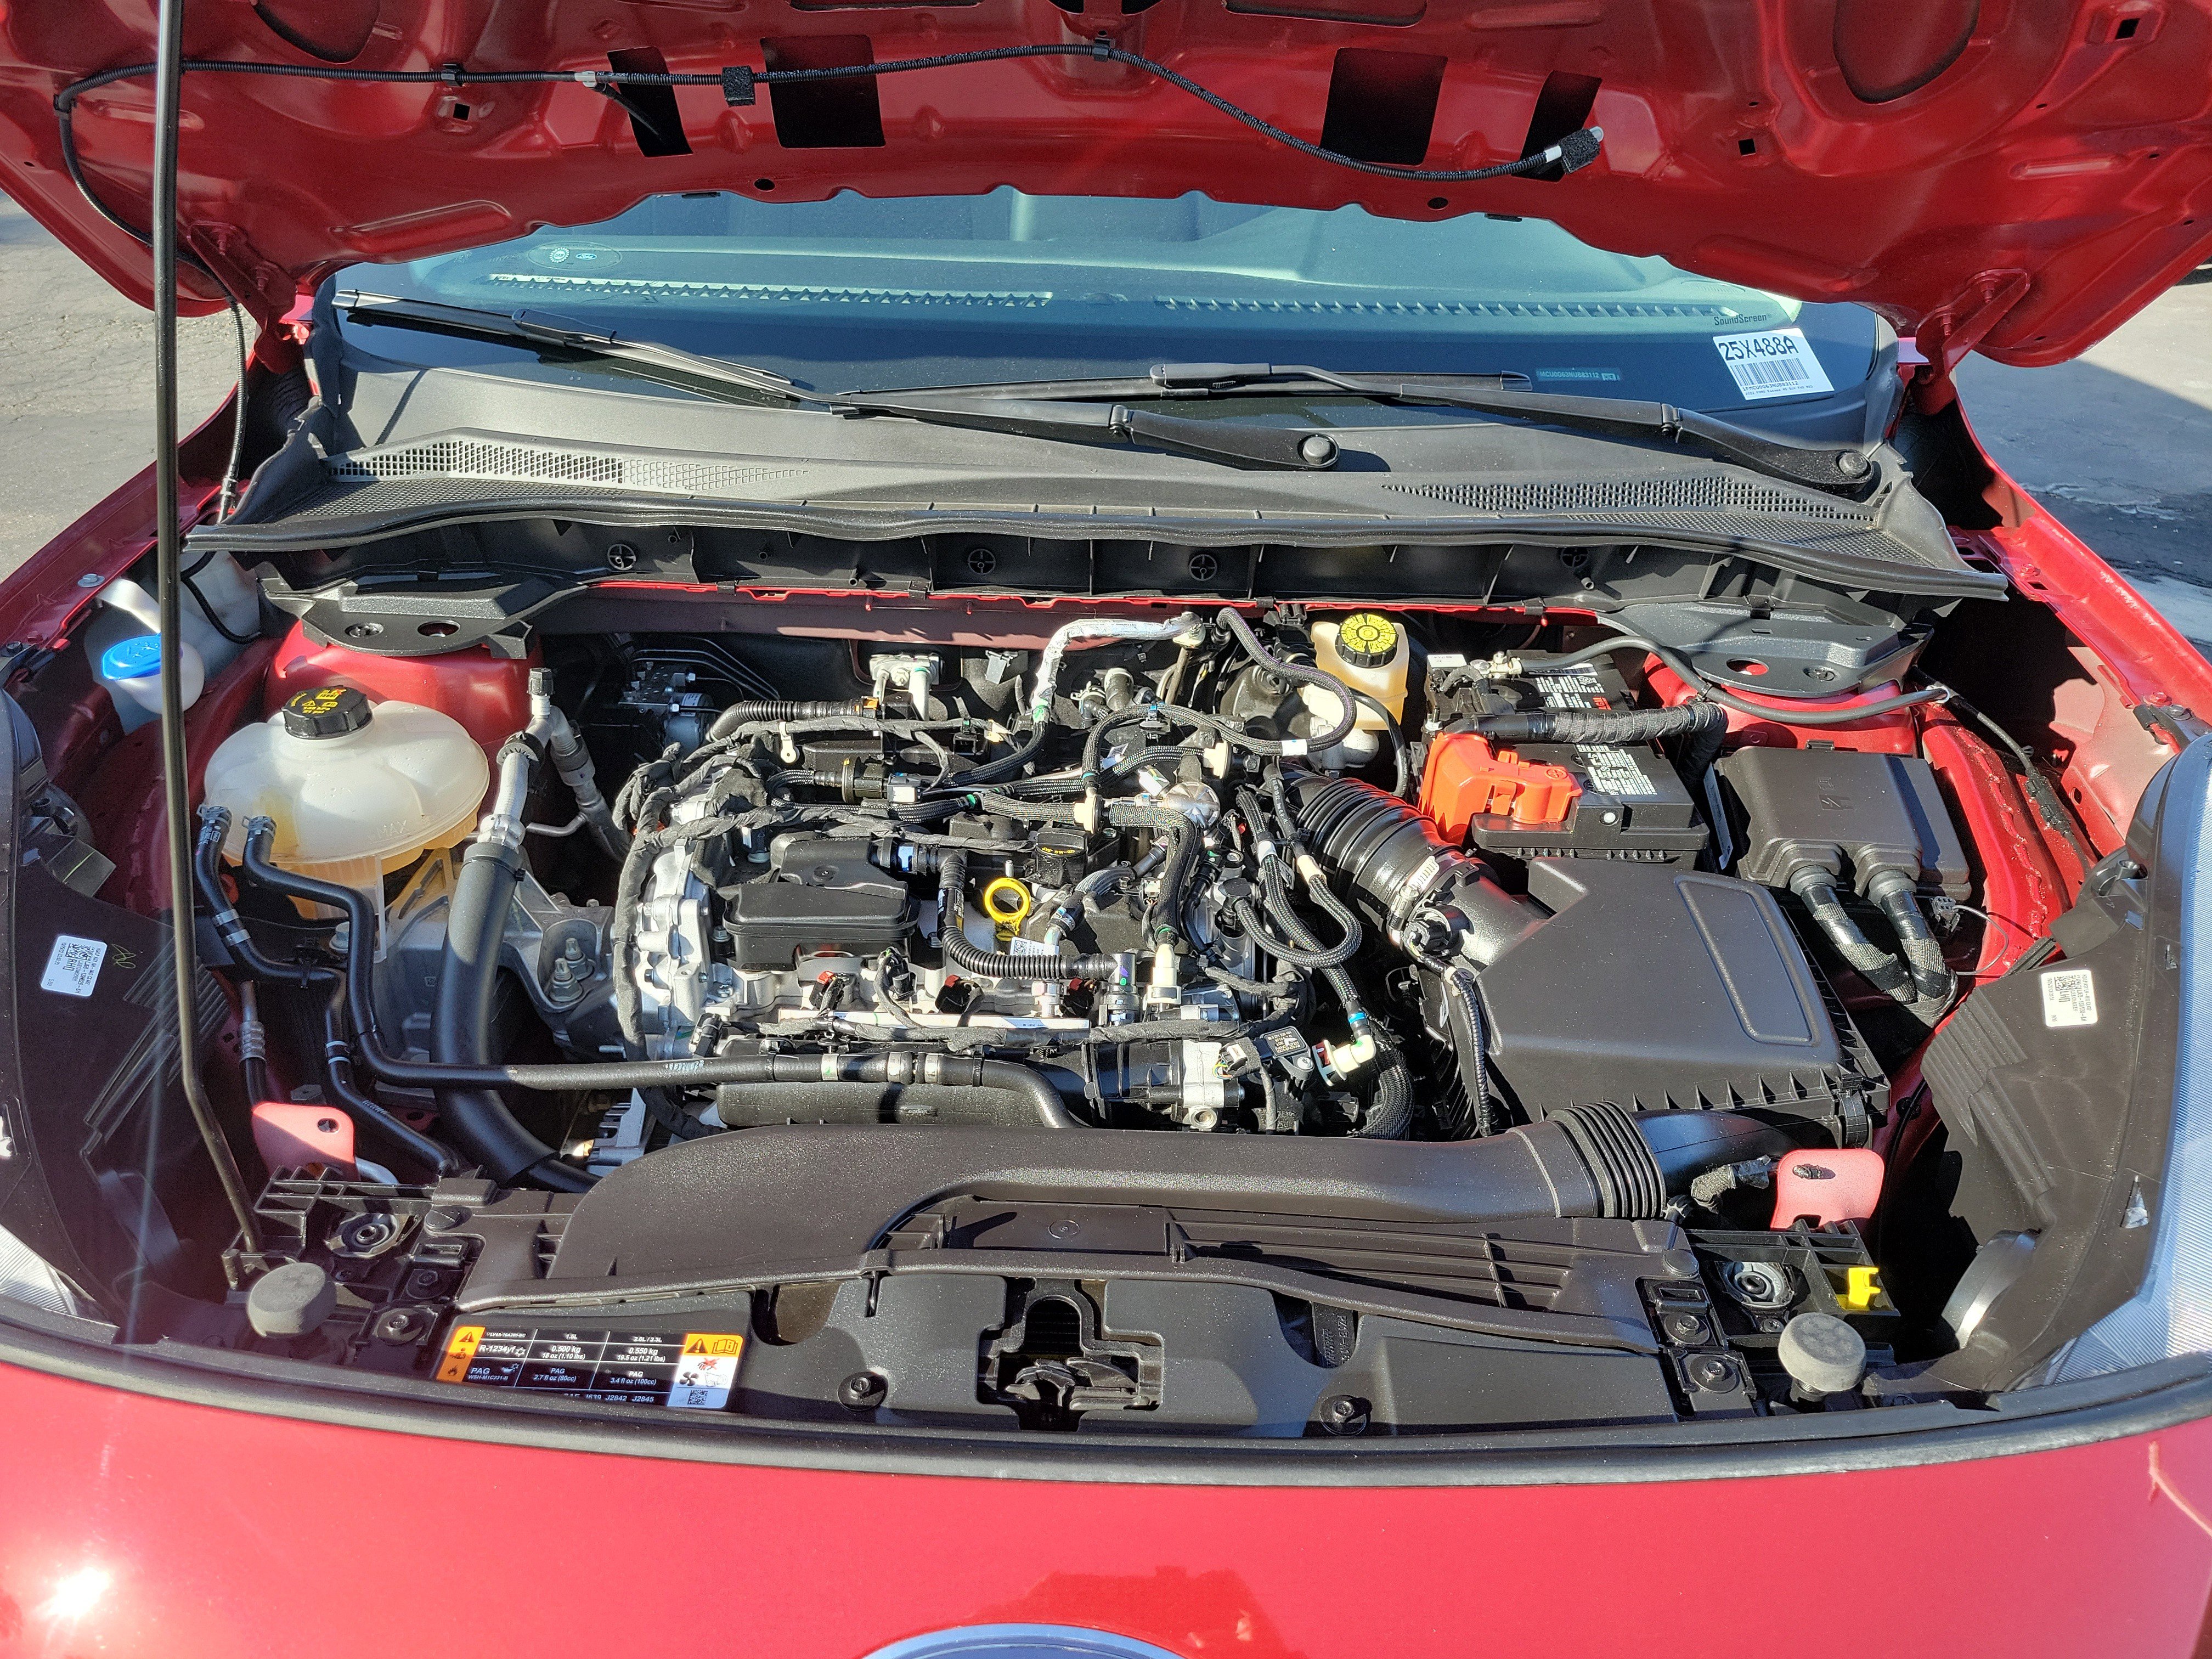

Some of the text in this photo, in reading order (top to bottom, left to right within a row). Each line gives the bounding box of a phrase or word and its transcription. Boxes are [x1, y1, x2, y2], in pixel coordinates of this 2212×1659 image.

[1714, 314, 1767, 326] SoundScreen
[1718, 336, 1799, 361] 25X488A
[479, 1345, 517, 1353] R-1234yf
